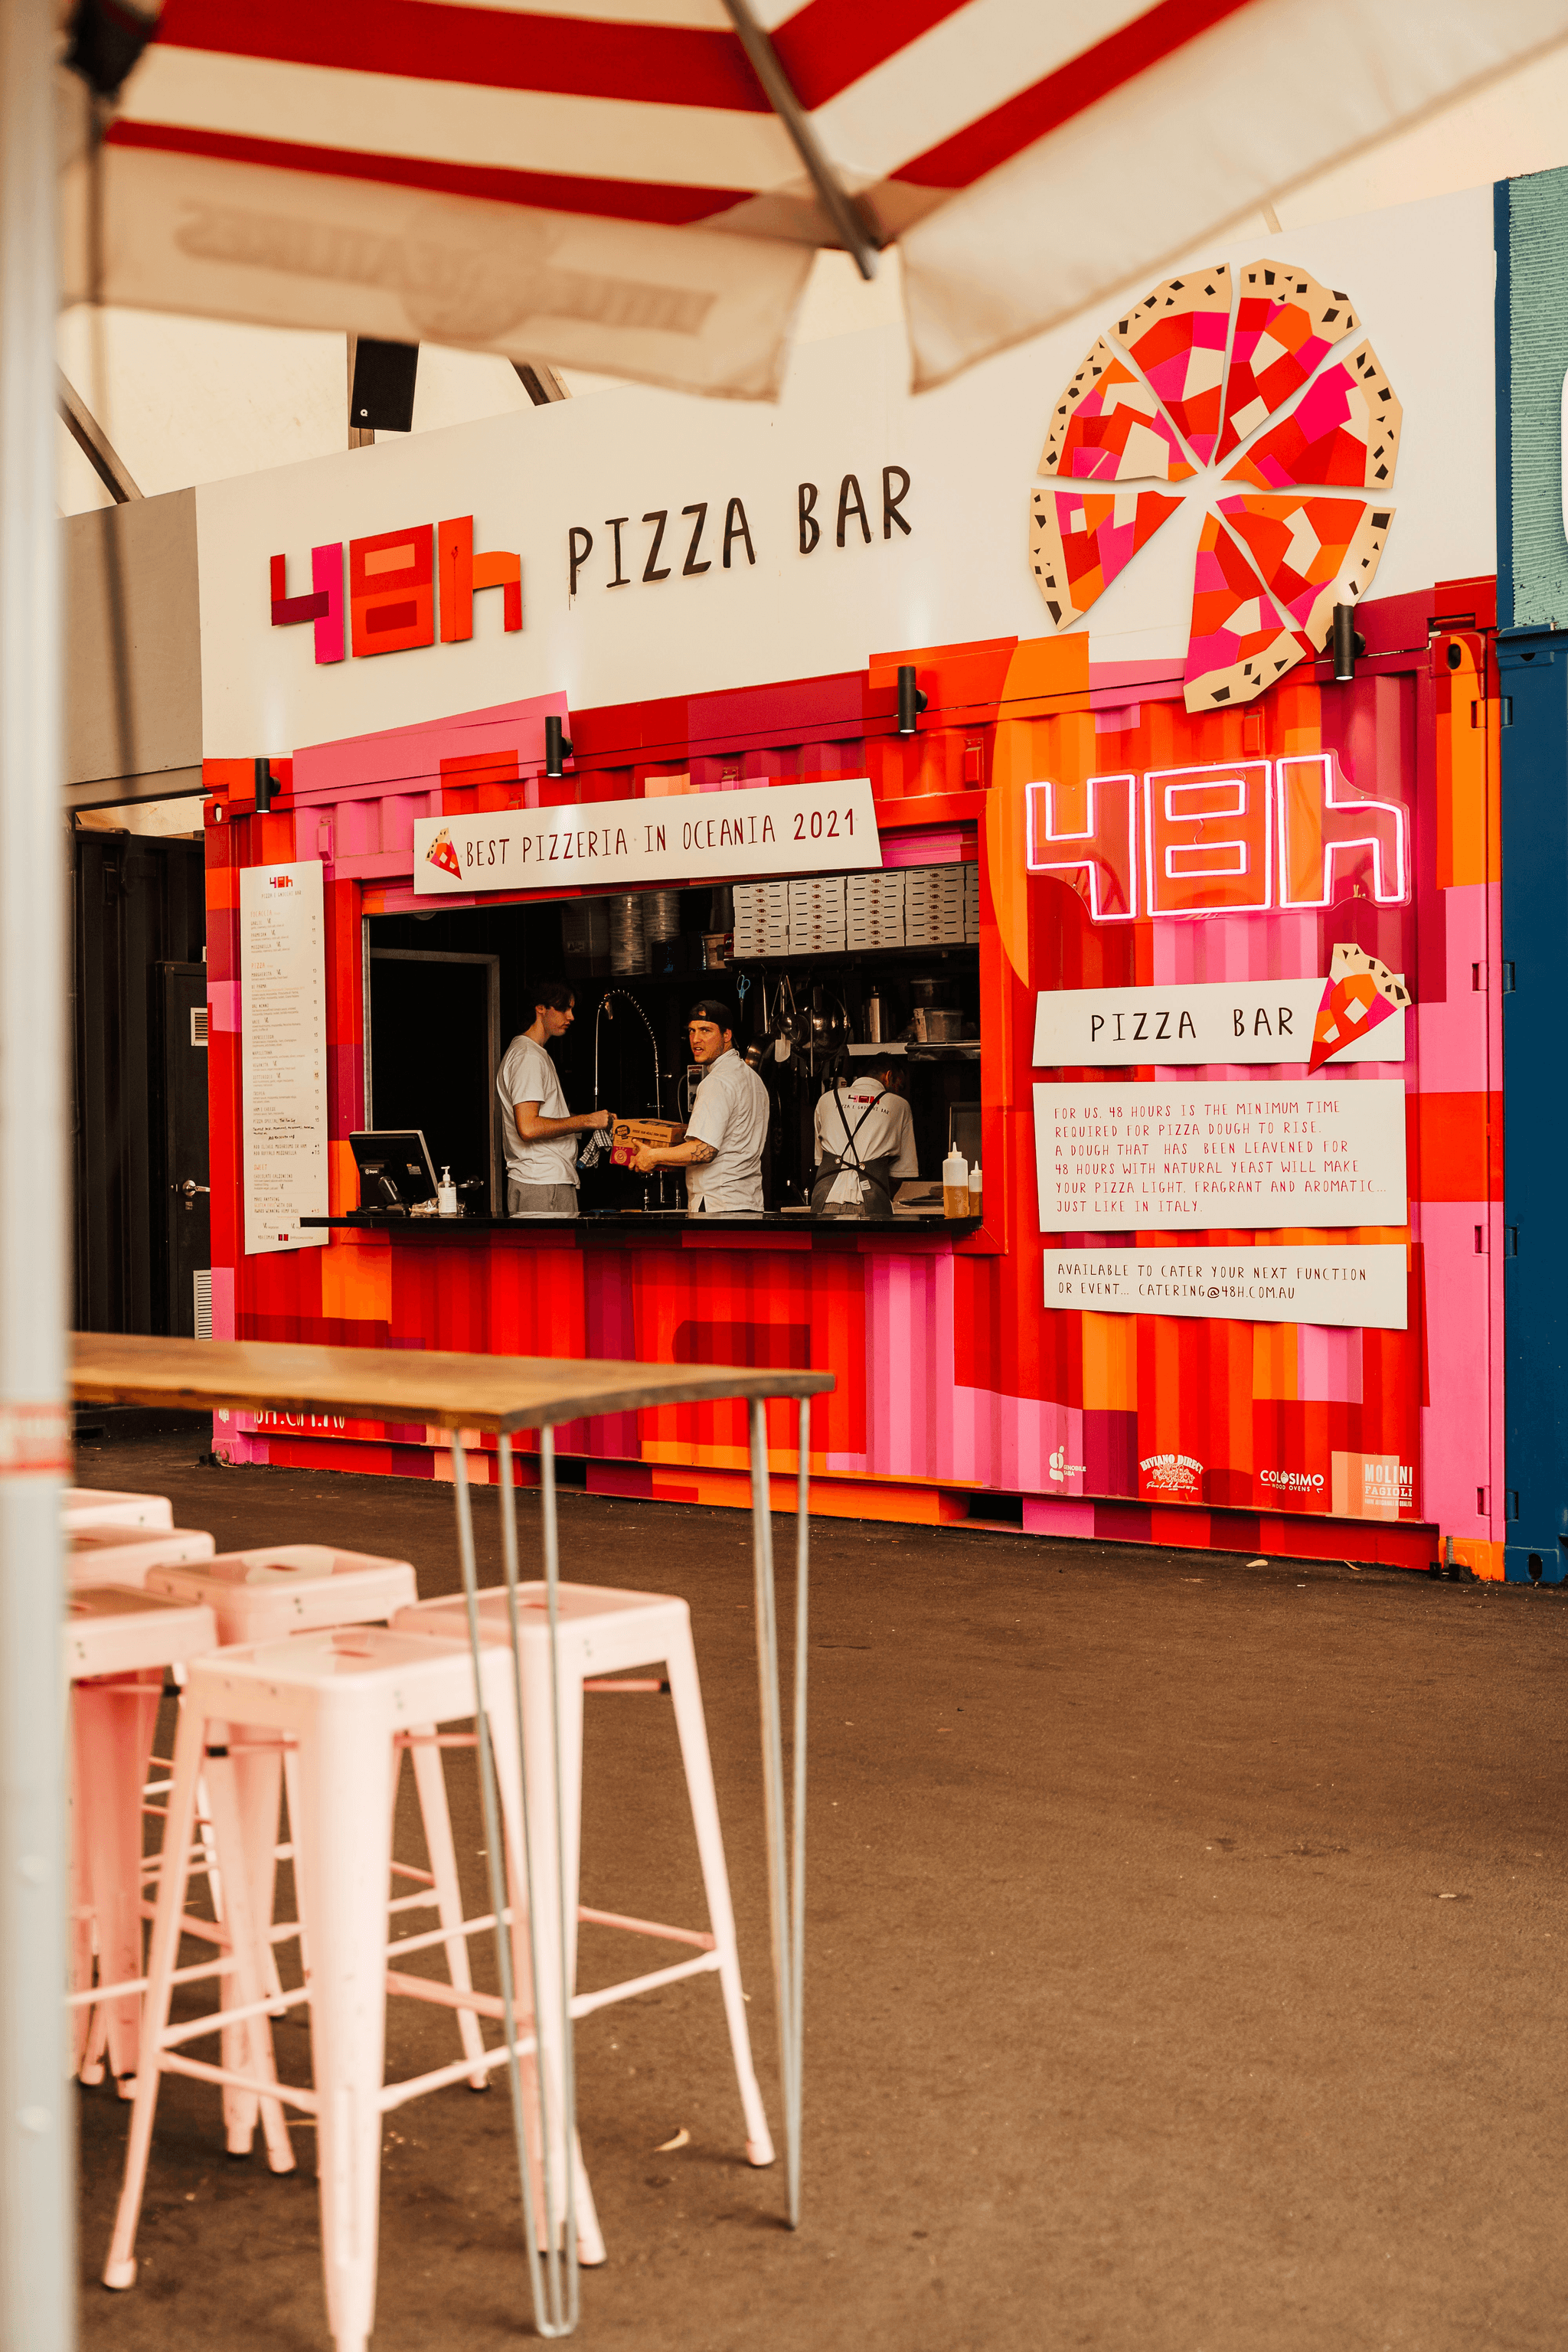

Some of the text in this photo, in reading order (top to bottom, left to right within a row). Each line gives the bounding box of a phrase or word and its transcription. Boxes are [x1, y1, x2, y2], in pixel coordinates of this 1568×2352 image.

[569, 466, 912, 597] PIZZA BAR
[270, 515, 523, 665] 48h
[467, 808, 854, 867] BEST PIZZERIA IN OCEANIA 2021
[1026, 754, 1406, 920] 48h
[1092, 1008, 1292, 1042] PIZZA BAR
[1055, 1108, 1075, 1119] FOR
[1110, 1107, 1122, 1117] 48
[1132, 1106, 1171, 1117] HOURS
[1181, 1105, 1194, 1116] IS
[1204, 1104, 1227, 1116] THE
[1237, 1102, 1298, 1115] MINIMUM
[1307, 1101, 1338, 1112] TIME
[1056, 1121, 1321, 1137] REQUIRED FOR PIZZA DOUGH TO RISE.
[1056, 1141, 1347, 1156] A DOUGH THAT HAS BEEN LEAVENED FOR
[1056, 1161, 1357, 1174] 48 HOURS WITH NATURAL YEAST WILL MAKE
[1057, 1183, 1086, 1193] YOUR
[1096, 1182, 1134, 1193] PIZZA
[1195, 1181, 1262, 1192] FRAGRANT
[1271, 1181, 1295, 1192] AND
[1057, 1200, 1203, 1212] JUST LIKE IN ITALY.
[1058, 1264, 1365, 1280] AVAILABLE TO CATER YOUR NEXT FUNCTION
[1059, 1282, 1072, 1293] OR
[1139, 1454, 1204, 1475] BIVIANO DIRECT
[1260, 1470, 1325, 1486] COLOSIMO
[1364, 1464, 1413, 1485] MOLINI
[1364, 1485, 1413, 1497] FAGIOLI
